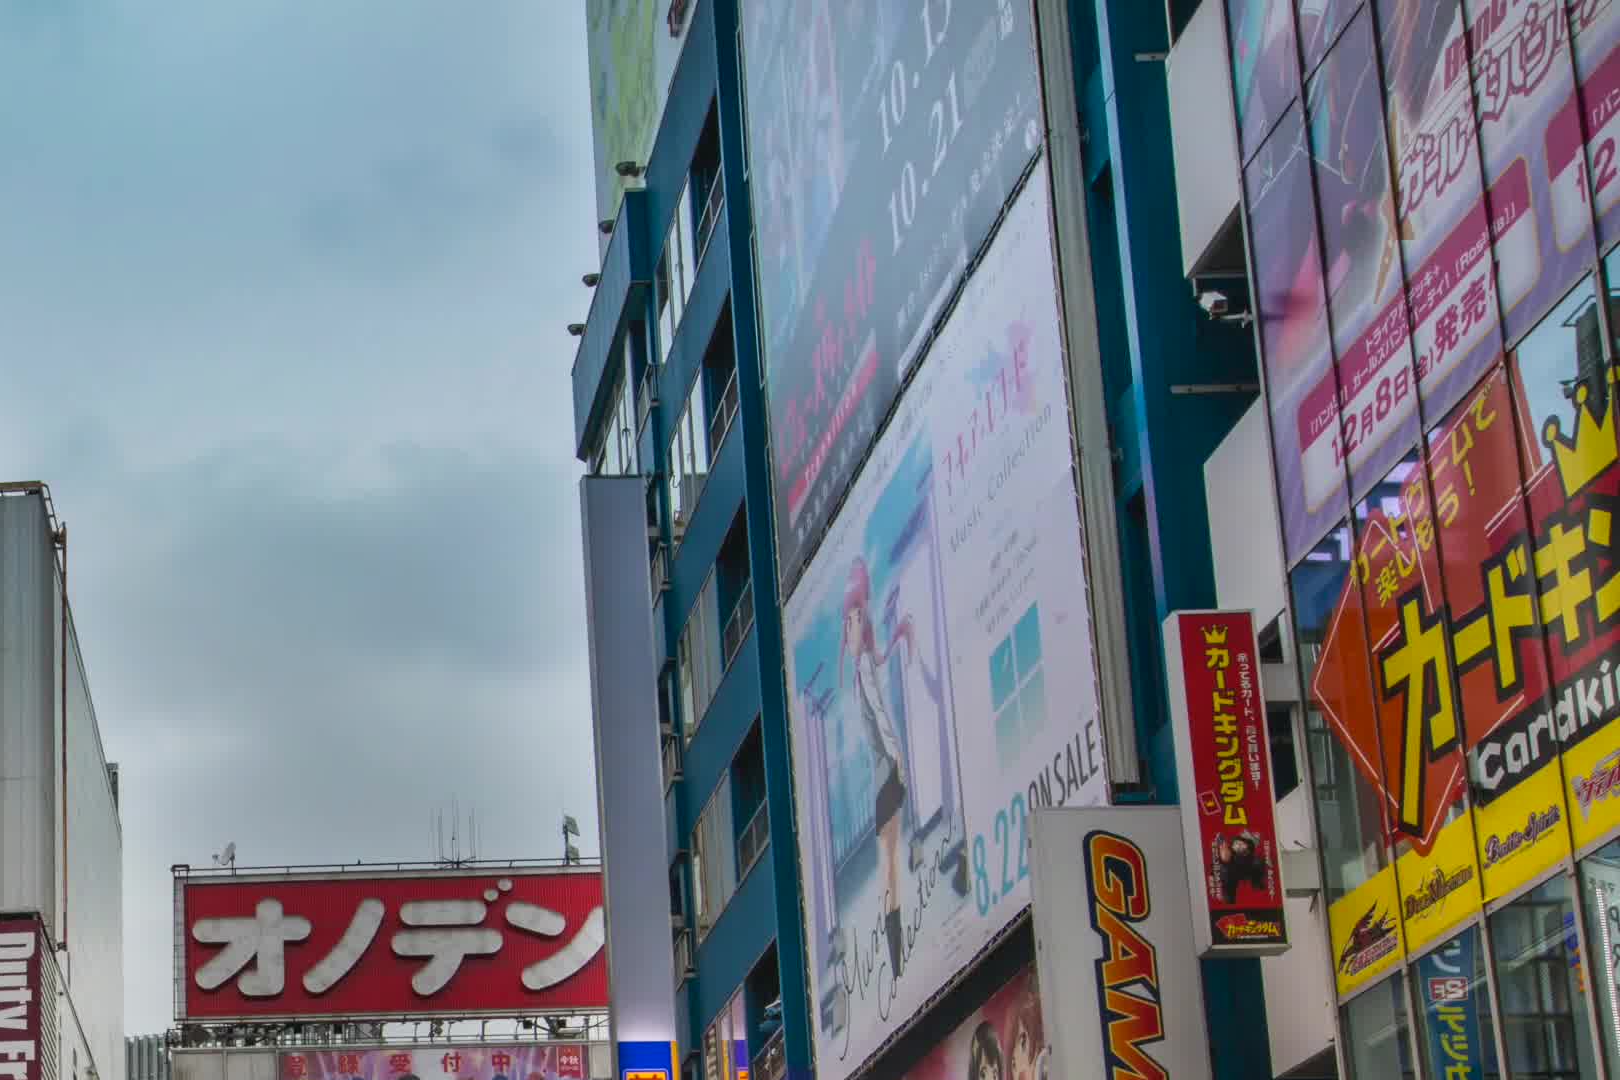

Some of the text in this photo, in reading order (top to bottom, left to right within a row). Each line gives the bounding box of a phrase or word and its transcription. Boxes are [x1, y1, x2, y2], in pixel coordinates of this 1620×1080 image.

[890, 68, 962, 255] 10.21
[1053, 719, 1100, 806] SALE
[1203, 646, 1250, 827] カードキングダム
[972, 792, 1030, 918] 8.22
[192, 878, 605, 997] オノデン
